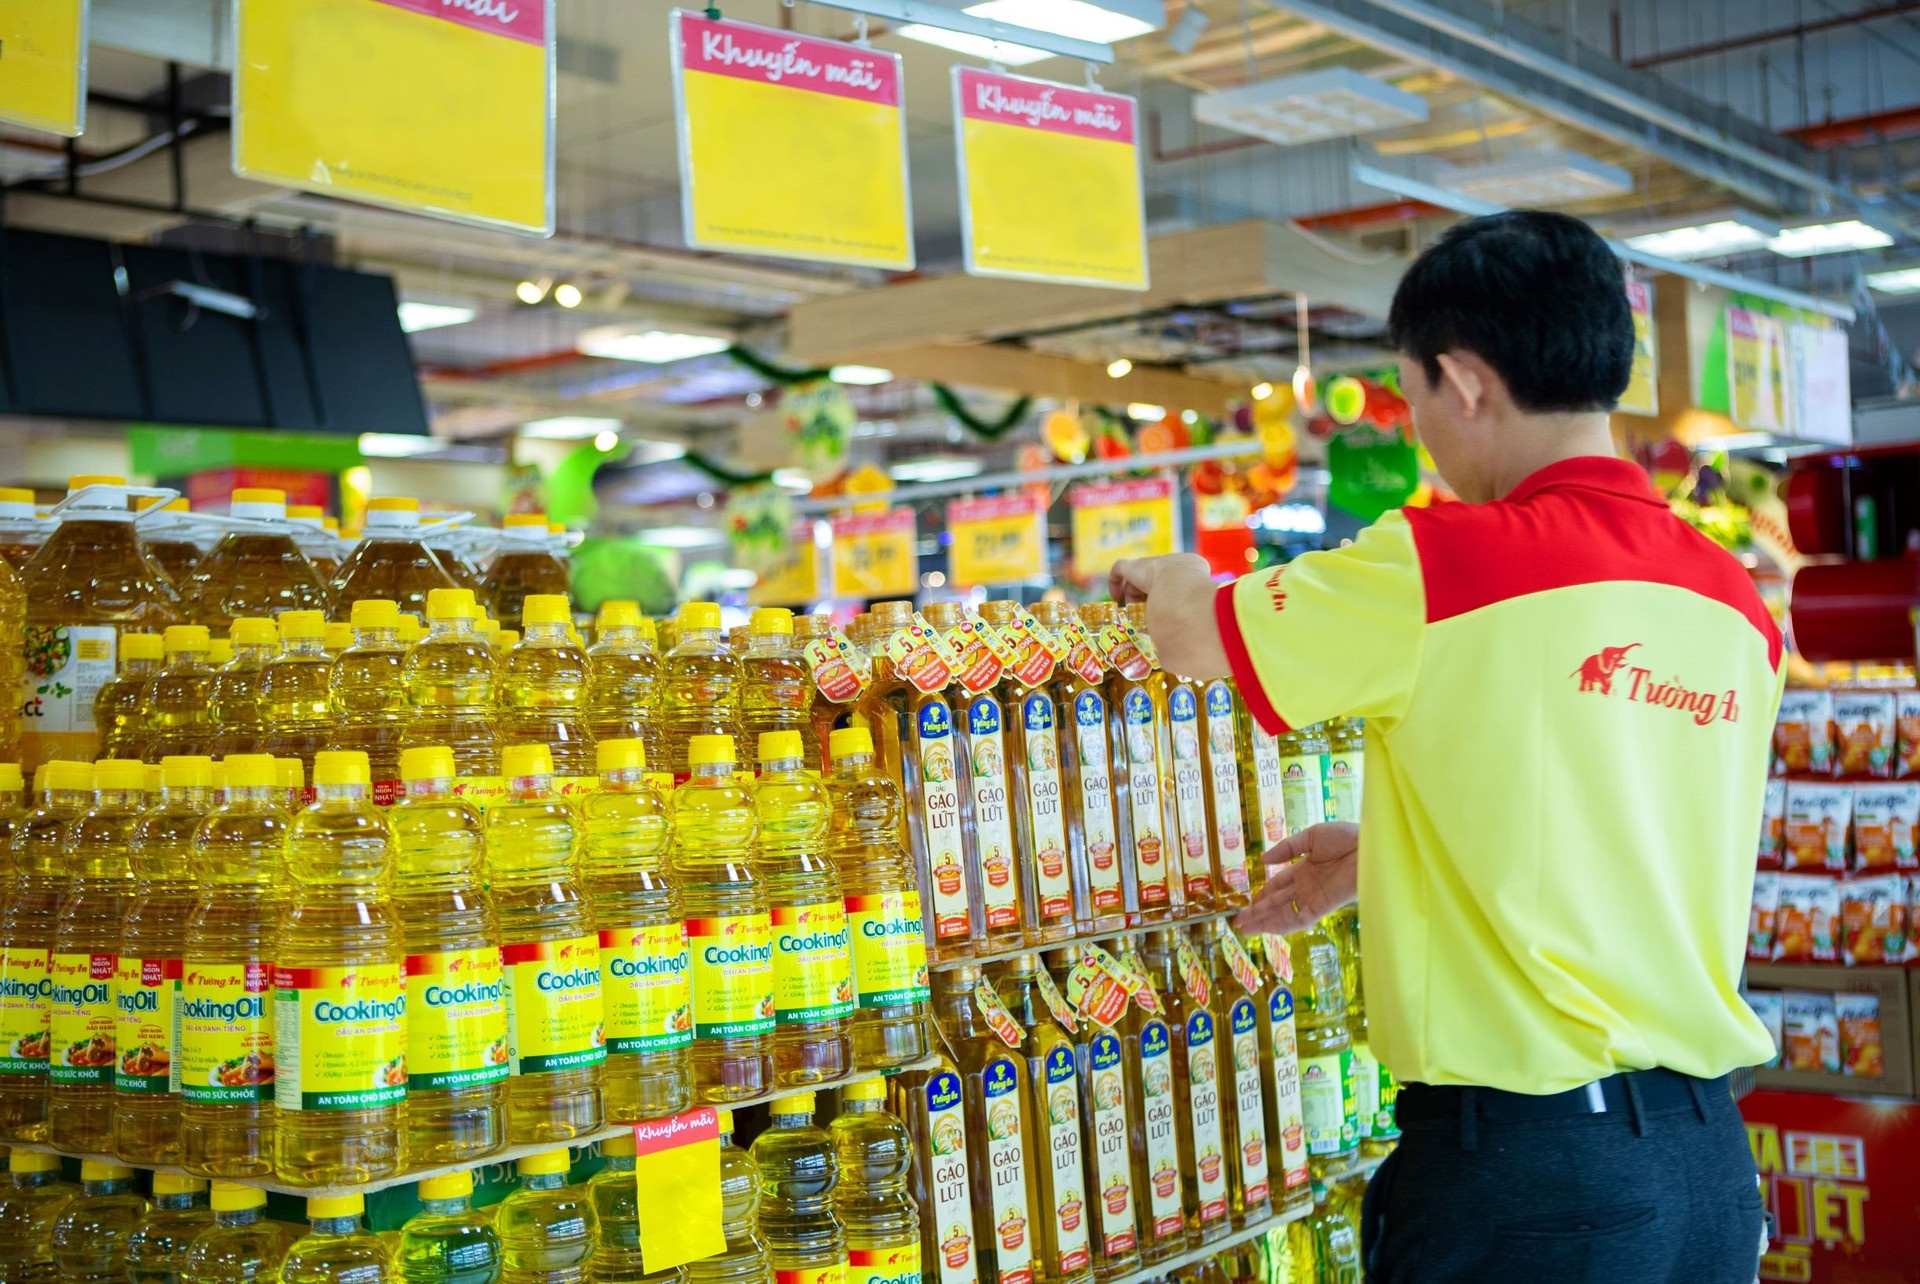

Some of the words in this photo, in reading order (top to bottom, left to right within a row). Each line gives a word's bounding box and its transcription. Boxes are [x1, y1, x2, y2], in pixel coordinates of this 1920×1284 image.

[703, 30, 821, 79] Khuyến
[825, 59, 882, 91] mãi
[977, 82, 1070, 125] Khuyến
[1074, 103, 1121, 131] mãi
[898, 637, 914, 653] 5
[948, 636, 964, 652] 5
[1001, 633, 1017, 649] 5
[1627, 667, 1717, 726] Tường
[932, 811, 955, 829] LỨT
[982, 805, 1003, 823] LỨT
[945, 853, 951, 865] 5
[862, 917, 924, 937] Cooking
[779, 928, 848, 952] CookingO
[704, 941, 772, 963] CookingO
[91, 966, 112, 975] NHẤT
[610, 951, 688, 977] CookingO
[142, 972, 162, 981] NHẤT
[538, 968, 601, 991] Cooking
[1075, 973, 1090, 989] 5
[0, 978, 52, 1000] kingO
[53, 983, 109, 1007] kingOil
[425, 979, 504, 1004] CookingO
[873, 995, 884, 1003] AN
[884, 992, 903, 1001] TOÀN
[118, 990, 159, 1012] ingOil
[183, 997, 264, 1022] ookingOil
[315, 995, 406, 1021] CookingO
[787, 1012, 799, 1020] AN
[799, 1010, 820, 1020] TOÀN
[723, 1023, 744, 1033] TOÀN
[617, 1041, 629, 1049] AN
[630, 1038, 652, 1048] TOÀN
[545, 1059, 558, 1067] AN
[559, 1056, 580, 1066] TOÀN
[432, 1077, 445, 1085] AN
[446, 1074, 471, 1084] TOÀN
[212, 1089, 229, 1099] SỨC
[230, 1088, 255, 1099] KHỎE
[319, 1097, 332, 1105] AN
[333, 1094, 357, 1104] TOÀN
[638, 1117, 688, 1141] Khuyến
[690, 1112, 715, 1131] mãi
[936, 1163, 965, 1184] GẠO
[996, 1166, 1020, 1187] LỨT
[939, 1182, 965, 1203] LỨT
[953, 1224, 959, 1238] 5
